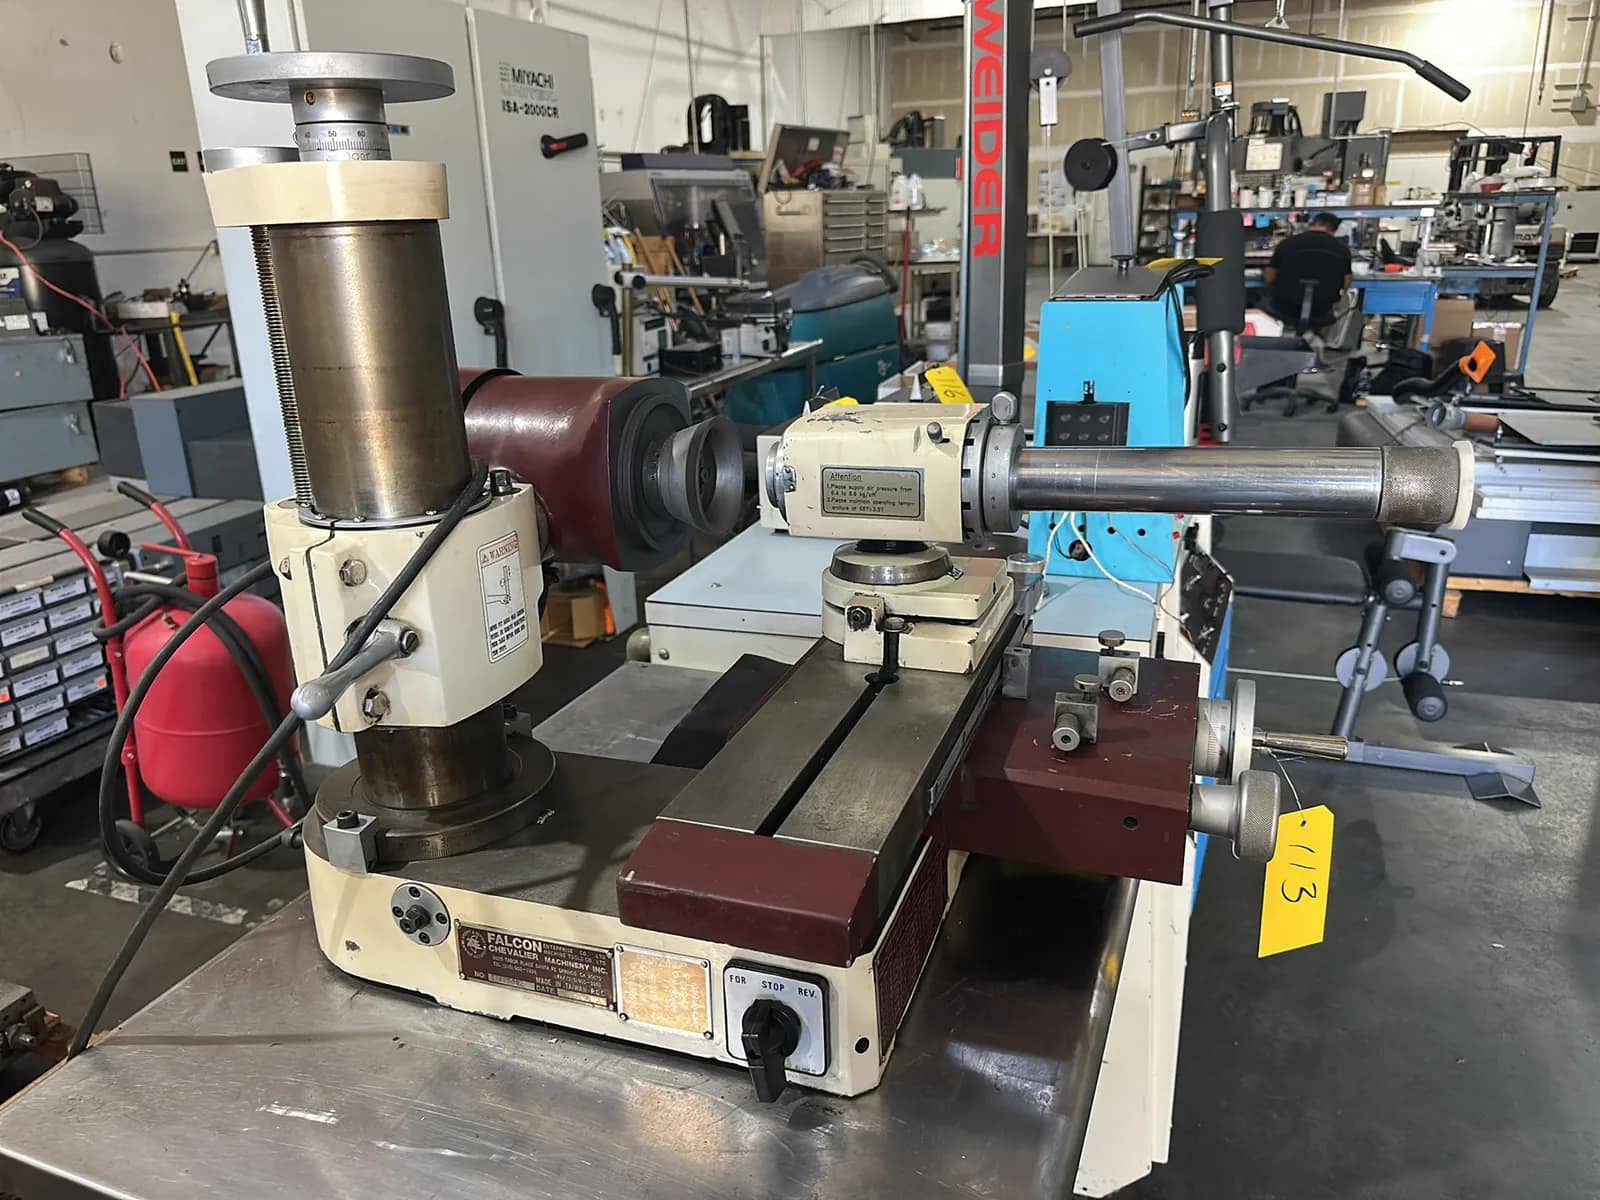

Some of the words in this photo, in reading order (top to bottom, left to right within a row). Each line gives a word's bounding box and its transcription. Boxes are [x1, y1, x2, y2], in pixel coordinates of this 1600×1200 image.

[511, 67, 554, 90] MIYACHI
[327, 130, 337, 138] 50
[357, 130, 366, 138] 60
[972, 0, 1005, 257] WEIDER
[830, 472, 862, 481] Attention
[489, 540, 520, 560] WARNING
[1281, 844, 1317, 903] 113
[487, 932, 543, 953] FALCON
[488, 944, 539, 960] CHEVALIER
[544, 956, 590, 971] MACHINERY
[592, 965, 609, 975] INC.
[729, 974, 747, 985] FOR
[761, 980, 785, 992] STOP
